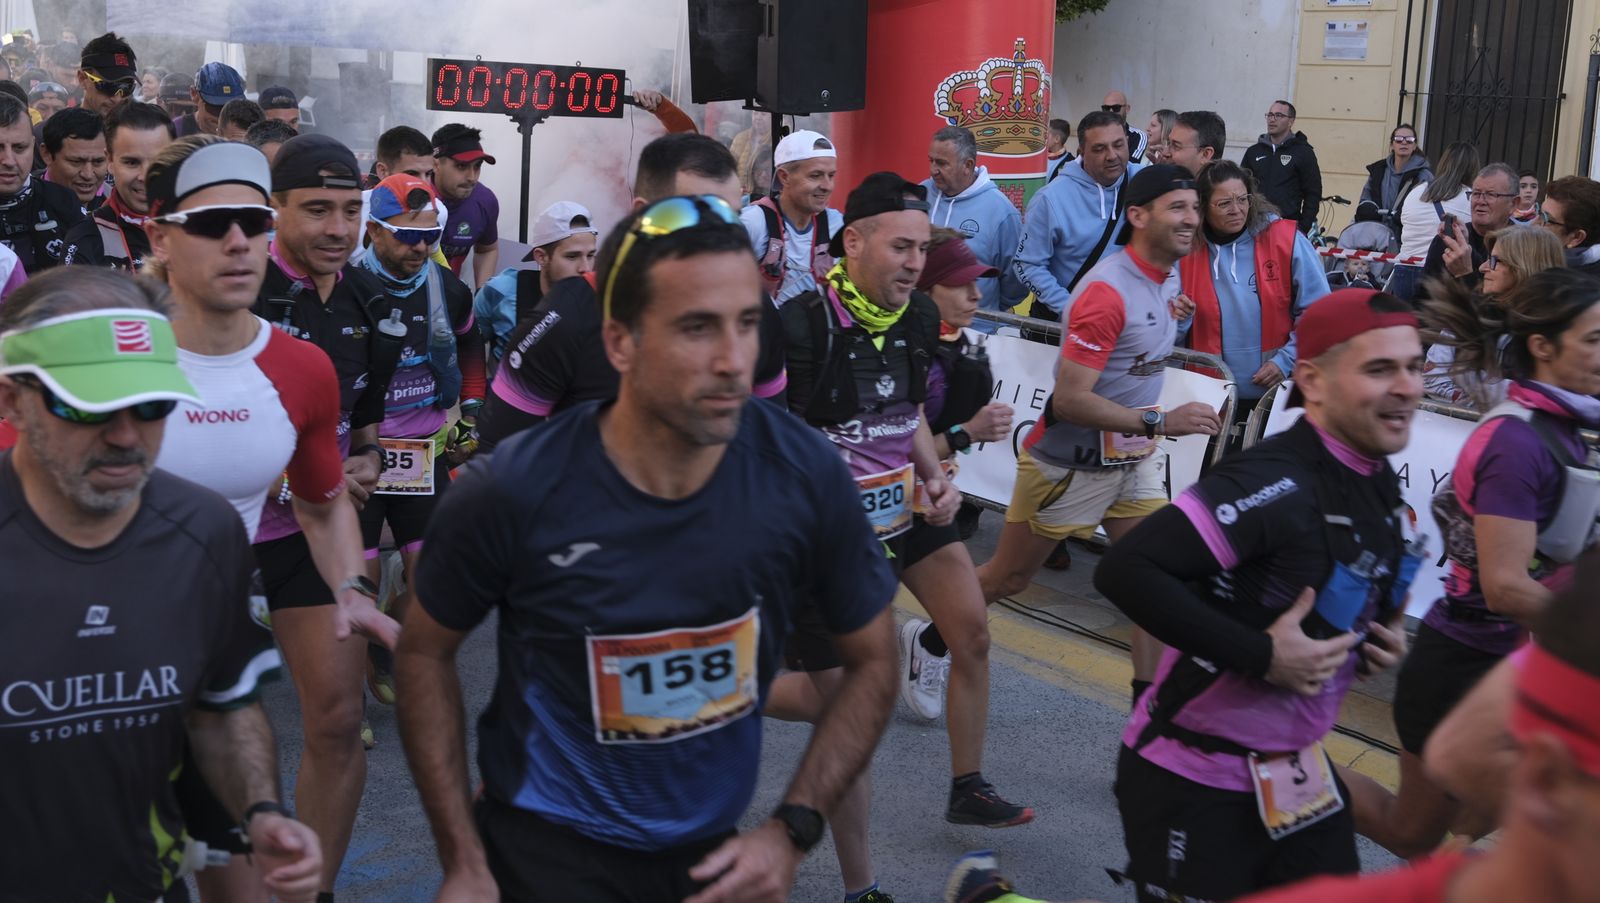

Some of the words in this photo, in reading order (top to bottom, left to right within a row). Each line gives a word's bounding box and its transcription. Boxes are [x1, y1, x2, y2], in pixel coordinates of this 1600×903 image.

[436, 64, 619, 113] 00:00:00
[185, 408, 251, 424] WONG
[862, 484, 905, 514] 320
[1, 664, 182, 717] CUELLAR
[624, 648, 733, 696] 158
[29, 720, 104, 743] STONE
